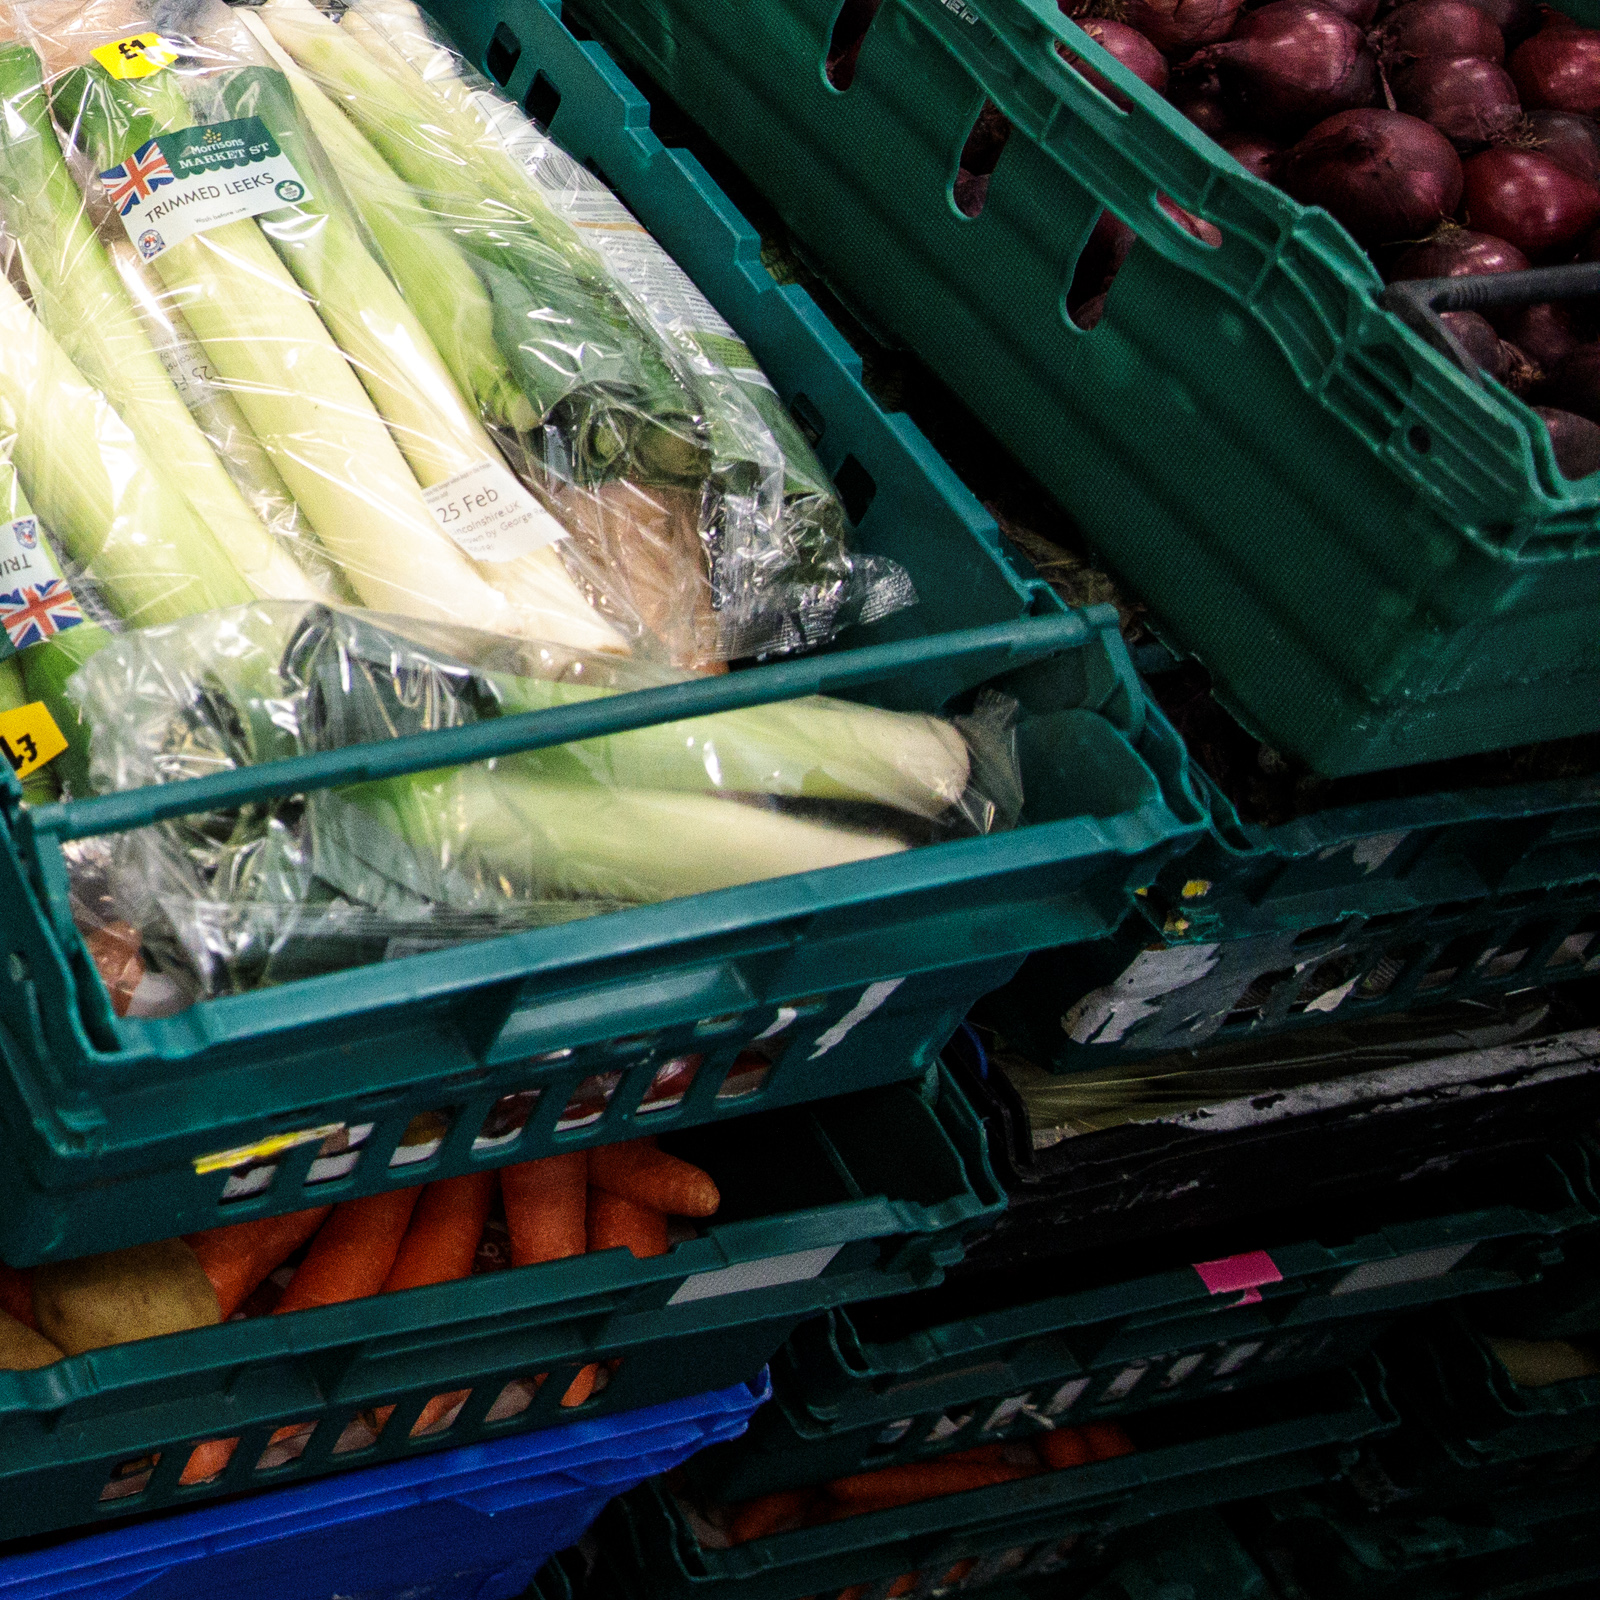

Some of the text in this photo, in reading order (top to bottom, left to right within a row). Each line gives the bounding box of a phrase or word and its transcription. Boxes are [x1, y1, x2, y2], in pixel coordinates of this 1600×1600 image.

[118, 39, 156, 60] £1
[178, 142, 270, 169] MARKET ST
[191, 138, 245, 155] Morrisons
[144, 185, 221, 224] TRIMMED
[224, 172, 275, 195] LEEKS
[193, 215, 212, 224] Wash
[212, 210, 234, 221] before
[437, 486, 499, 523] 25 Feb
[499, 511, 534, 532] George
